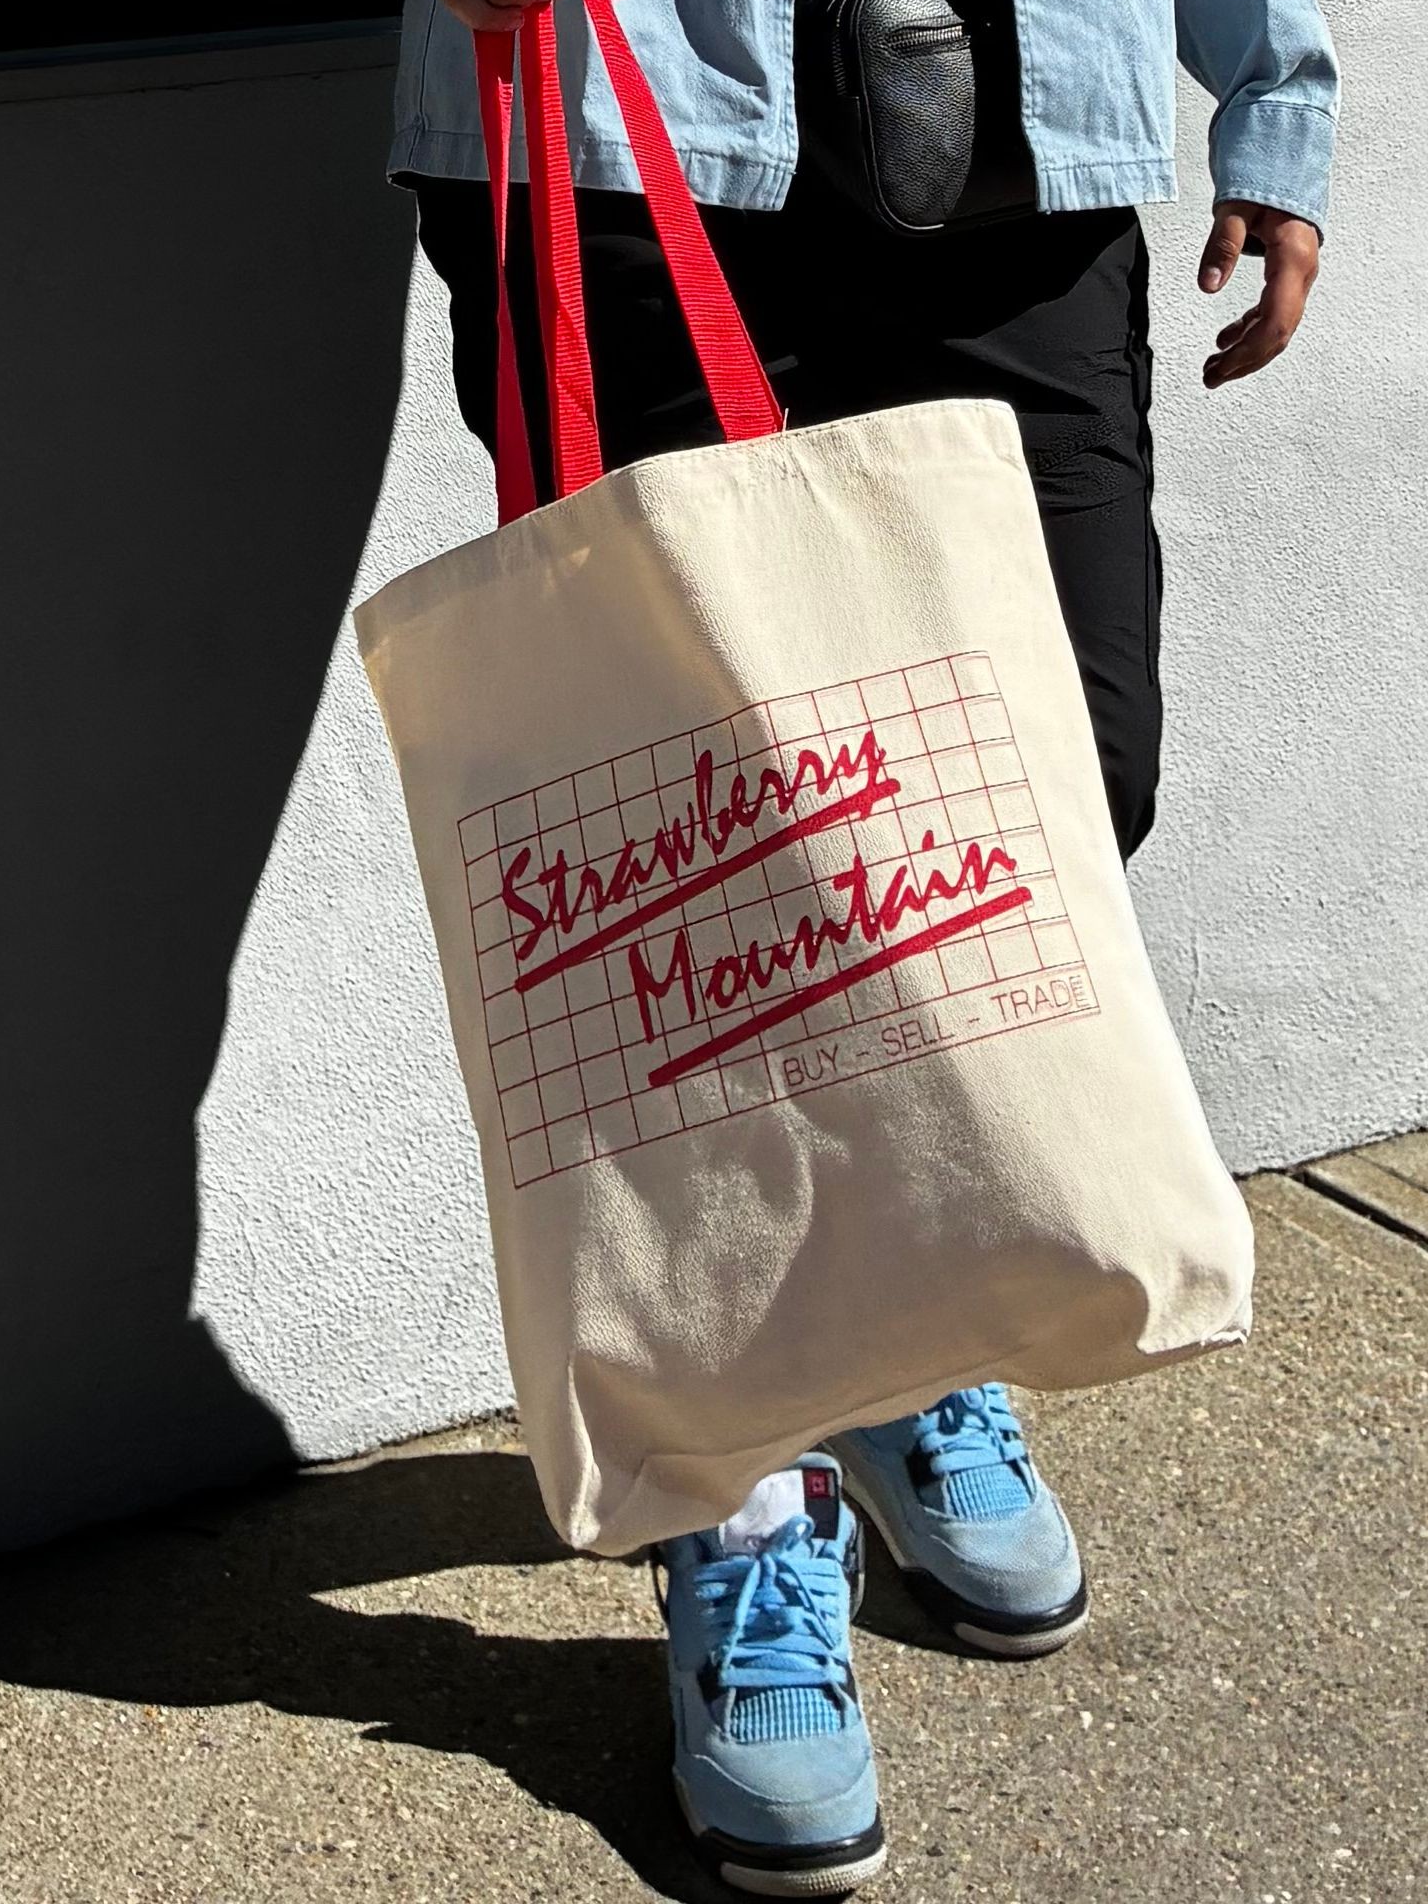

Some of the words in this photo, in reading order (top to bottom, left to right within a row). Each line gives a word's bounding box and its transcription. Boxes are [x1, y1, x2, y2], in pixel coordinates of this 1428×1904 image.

[501, 729, 886, 962] Strawberry
[628, 831, 1017, 1042] Mountain
[783, 1045, 839, 1087] BUY
[881, 1013, 955, 1057] SELL
[991, 975, 1090, 1023] TRADE
